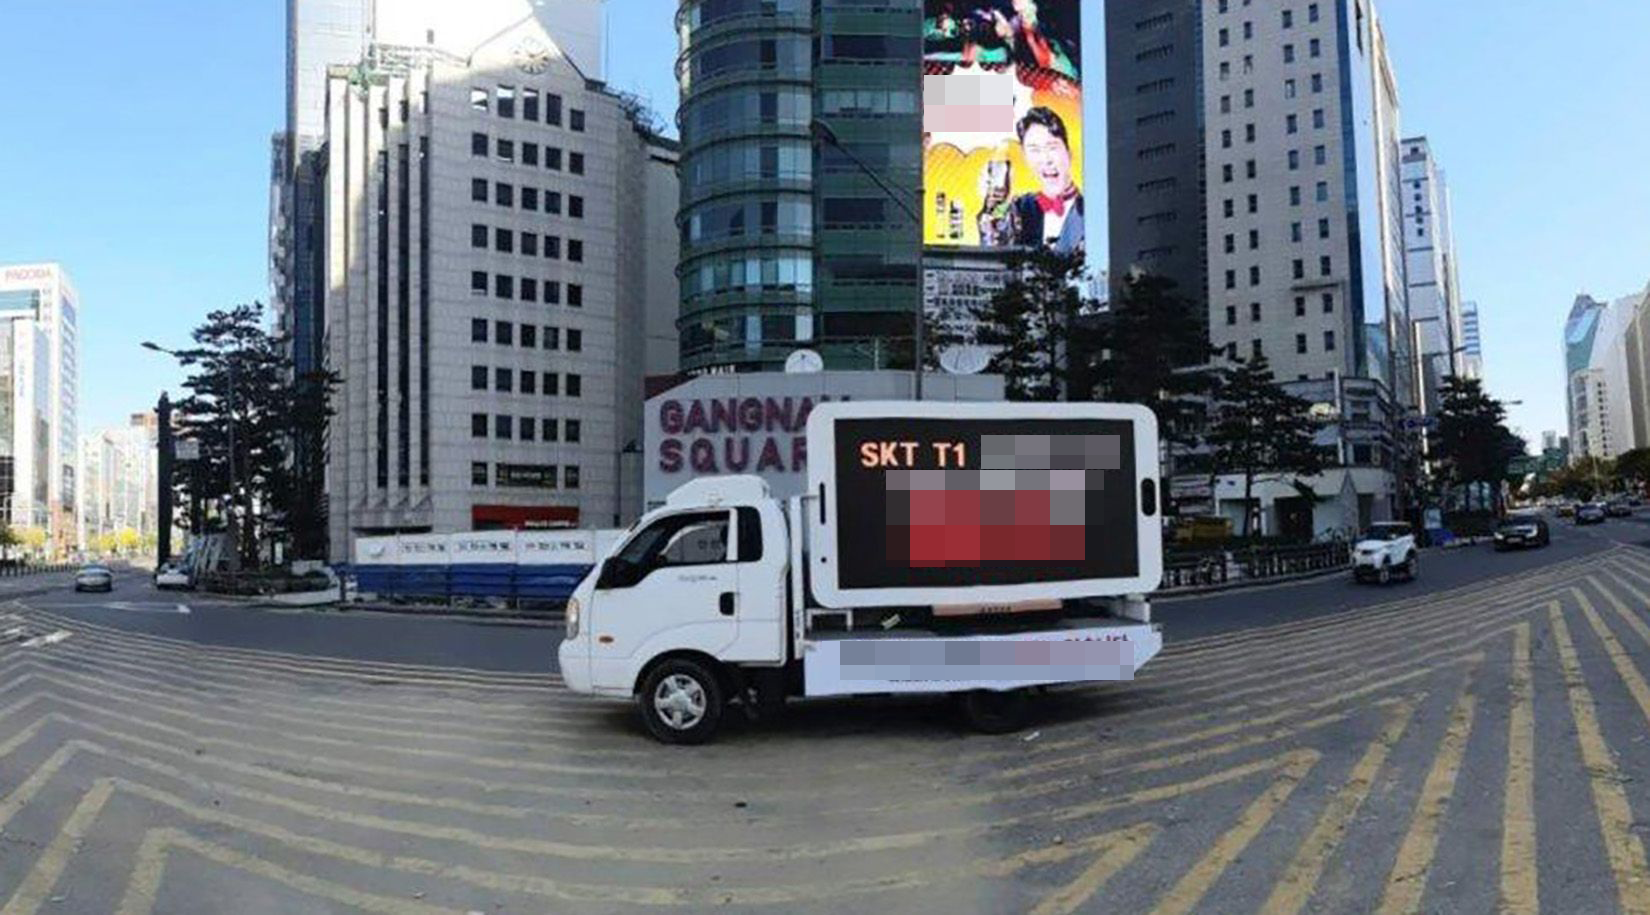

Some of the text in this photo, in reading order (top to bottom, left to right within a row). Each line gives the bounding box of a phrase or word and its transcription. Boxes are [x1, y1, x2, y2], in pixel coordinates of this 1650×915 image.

[660, 395, 851, 434] GANGNA
[861, 441, 965, 467] SKT T1
